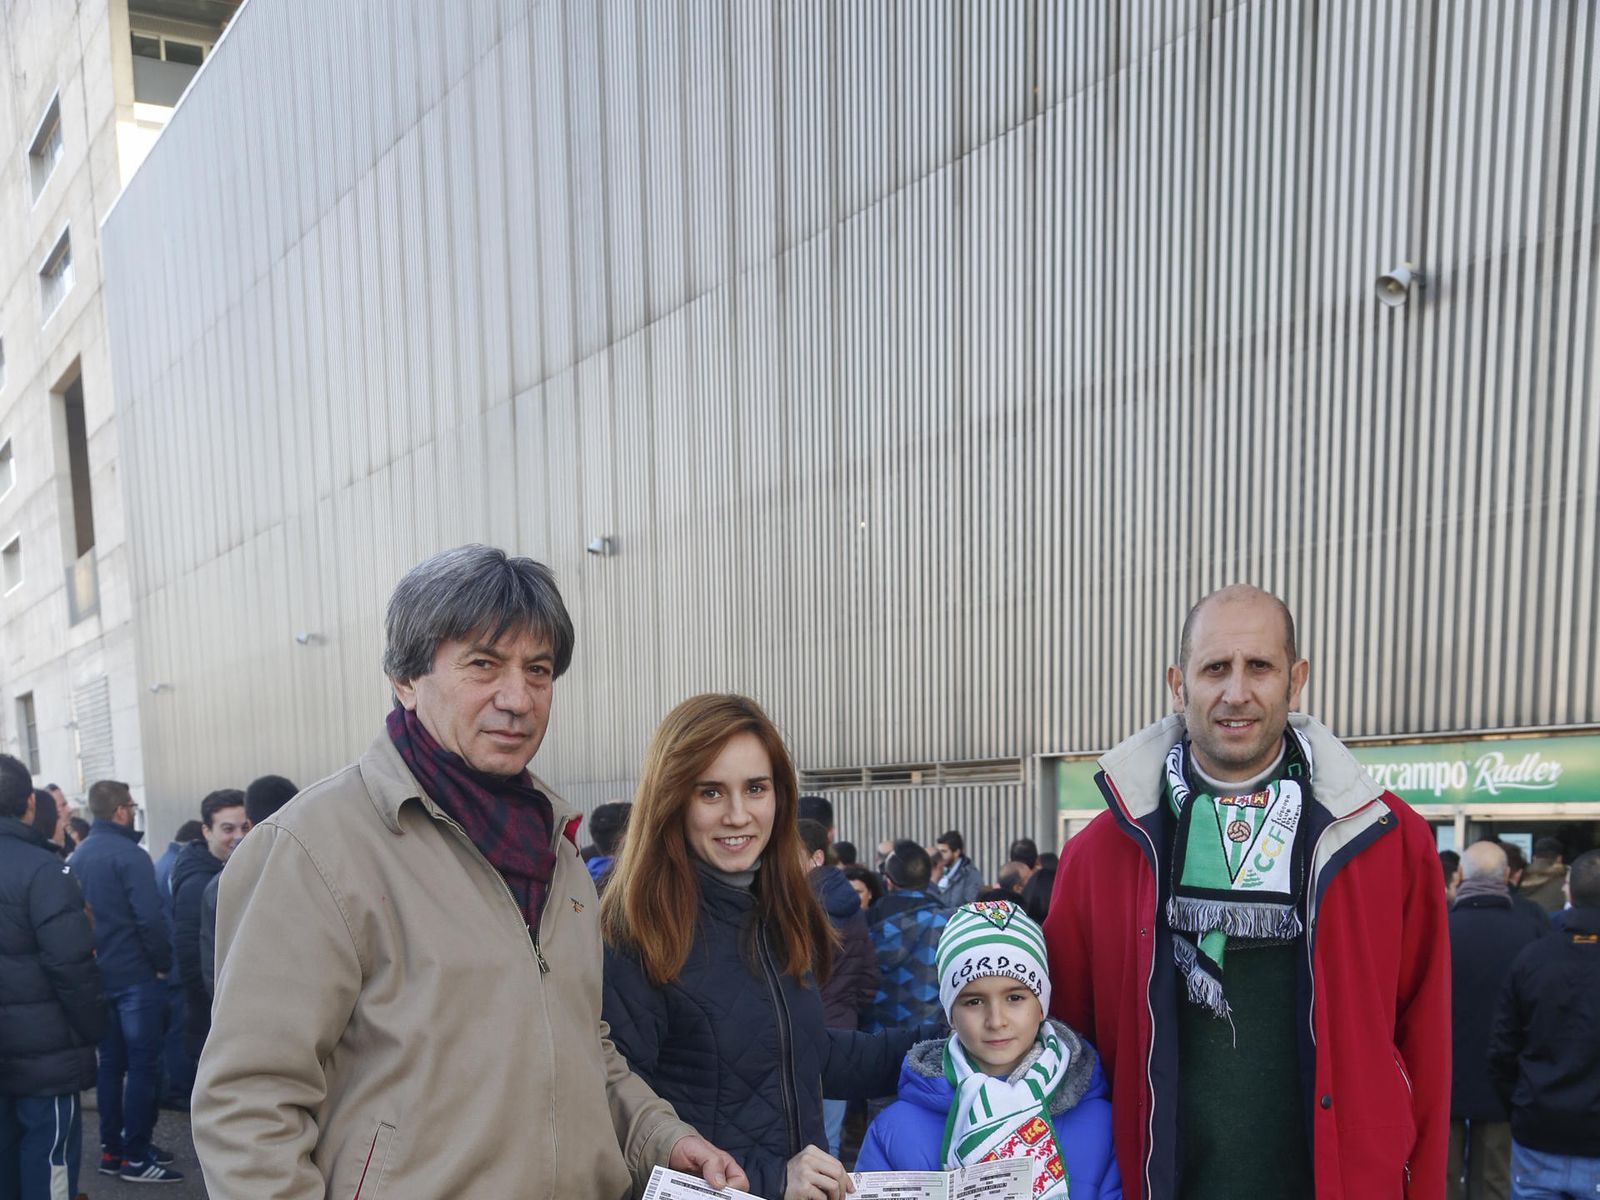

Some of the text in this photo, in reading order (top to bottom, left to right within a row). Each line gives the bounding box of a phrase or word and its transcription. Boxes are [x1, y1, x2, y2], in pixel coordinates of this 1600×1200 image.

[1473, 752, 1563, 795] Radler
[1254, 826, 1285, 872] CCF
[951, 956, 1042, 995] CÓRDOBA
